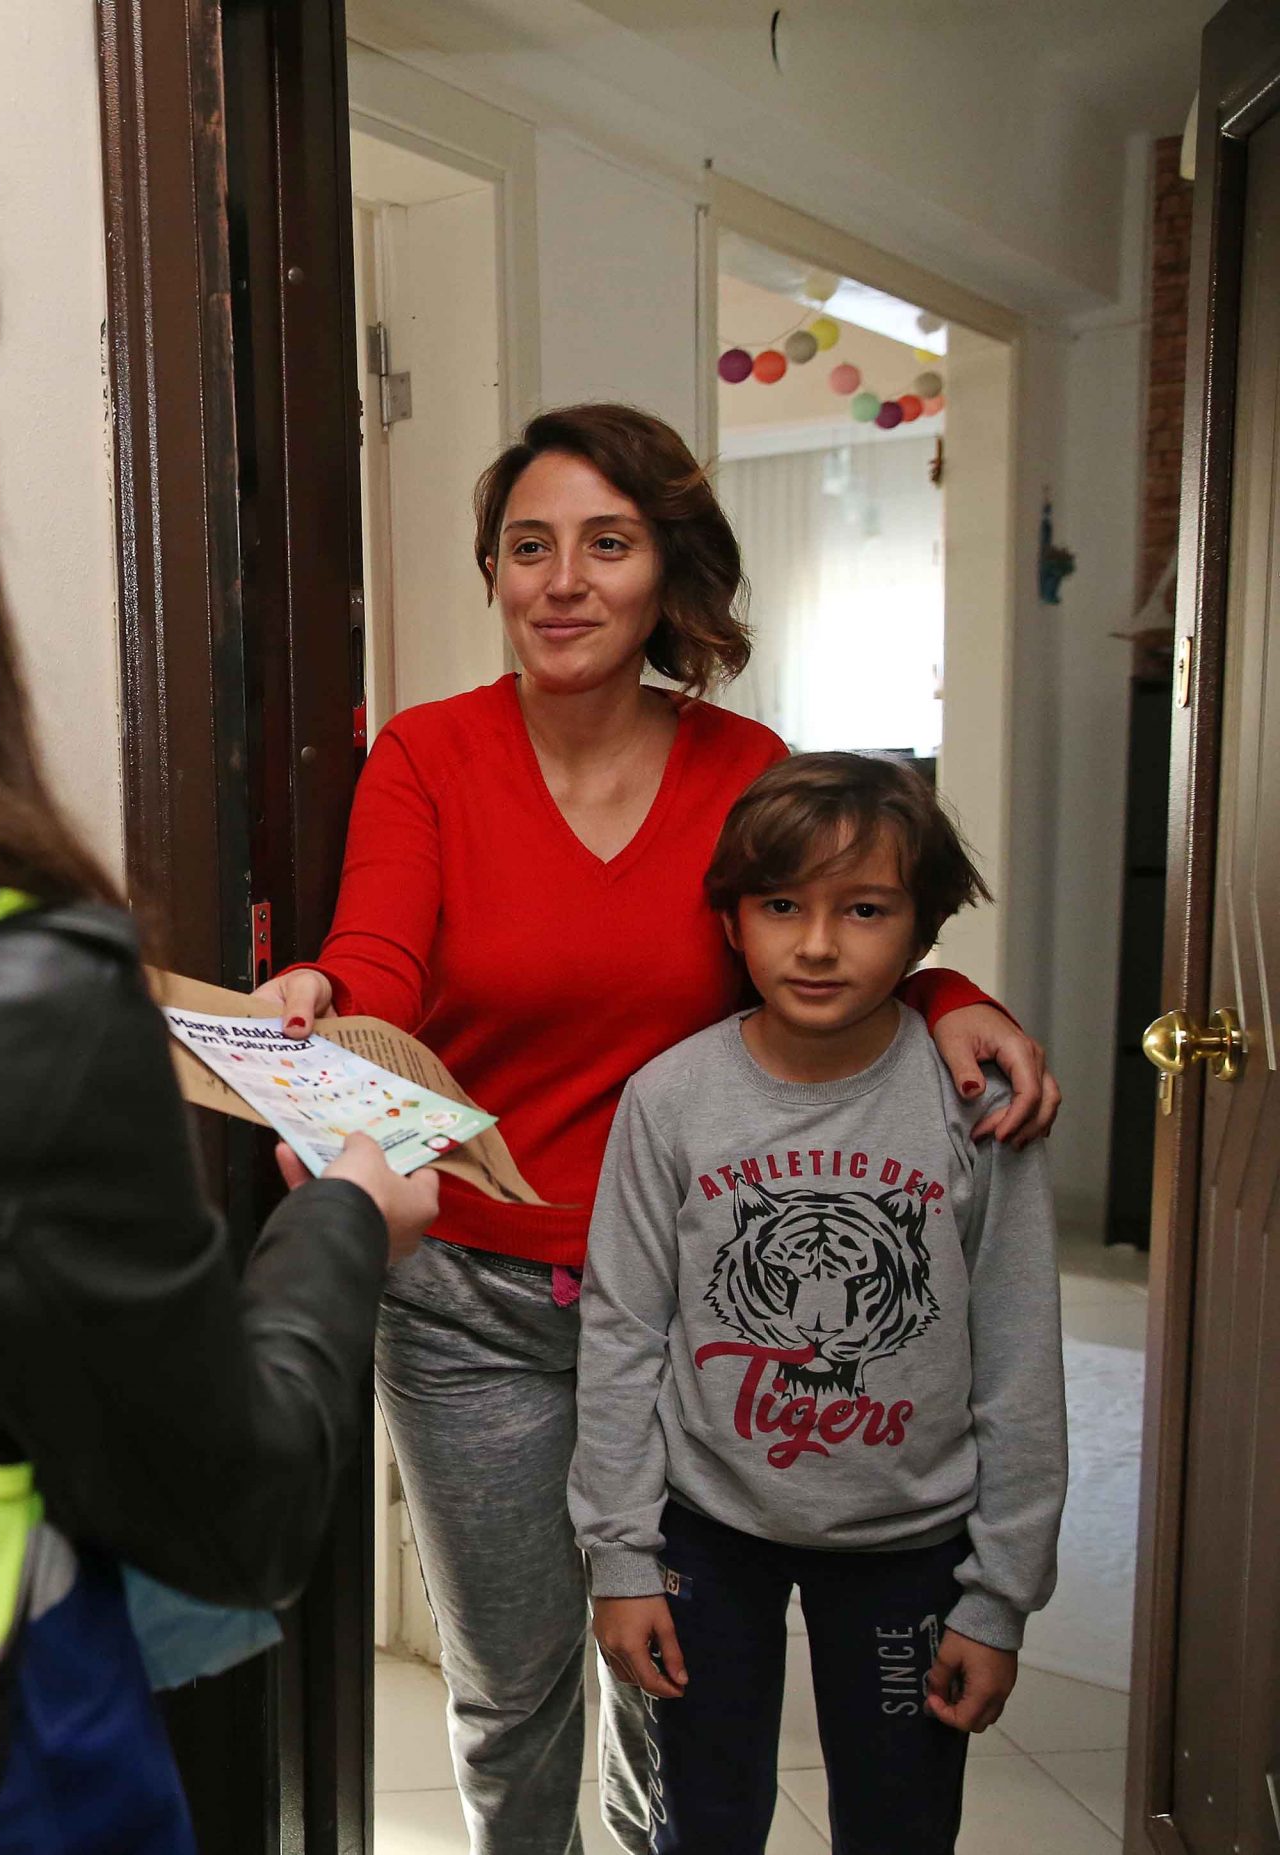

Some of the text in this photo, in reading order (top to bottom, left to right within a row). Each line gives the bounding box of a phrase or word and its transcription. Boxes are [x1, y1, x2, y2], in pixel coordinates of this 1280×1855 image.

[697, 1149, 869, 1201] ATHLETIC
[694, 1340, 914, 1470] Tigers
[875, 1626, 919, 1716] SINCE
